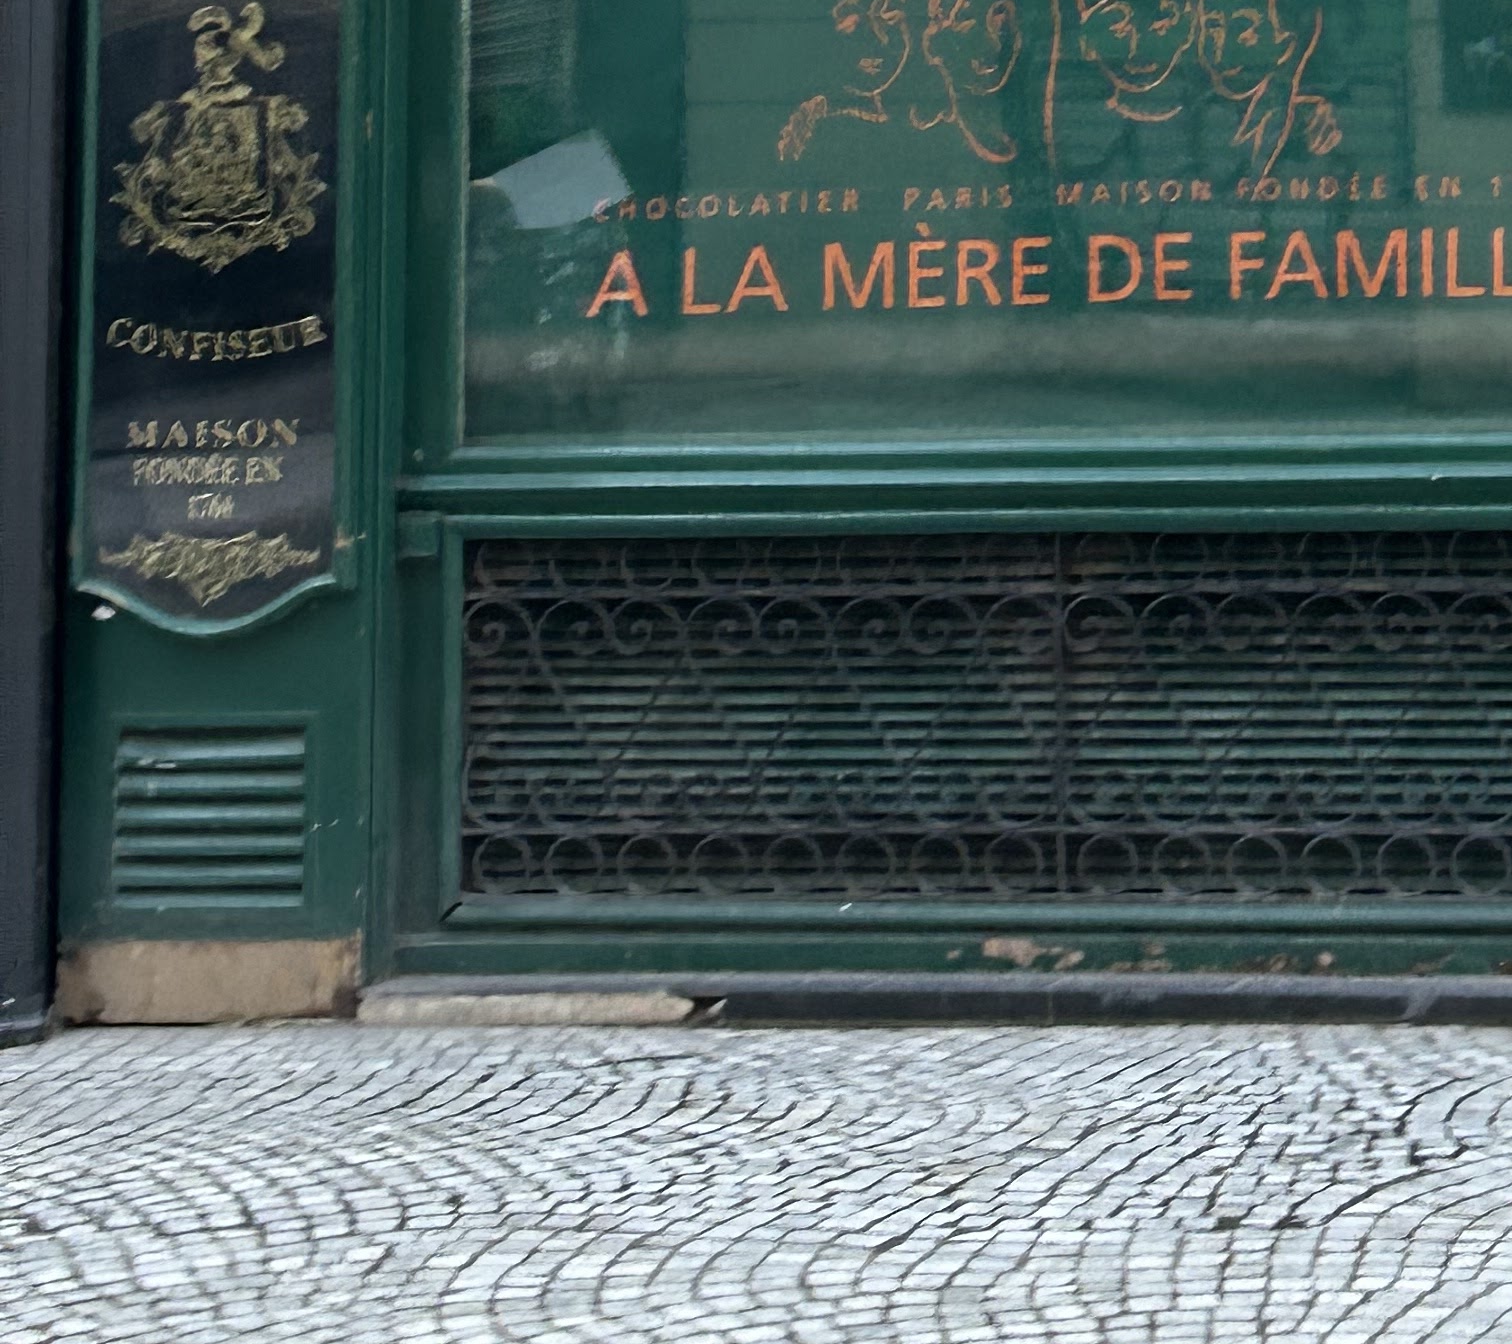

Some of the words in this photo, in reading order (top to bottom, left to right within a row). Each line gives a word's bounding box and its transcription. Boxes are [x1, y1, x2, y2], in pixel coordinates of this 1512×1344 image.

[593, 188, 861, 224] CHOCOLATIER
[901, 183, 1013, 211] PARIS
[1055, 178, 1213, 207] MAISON
[1235, 170, 1388, 202] FONDÉE
[1414, 173, 1463, 201] EN
[585, 247, 649, 318] A
[680, 243, 790, 316] LA
[821, 221, 1053, 311] MÈRE
[1087, 230, 1194, 304] DE
[105, 314, 329, 362] CONFISEUR
[125, 417, 300, 449] MAISON
[244, 455, 285, 486] EN
